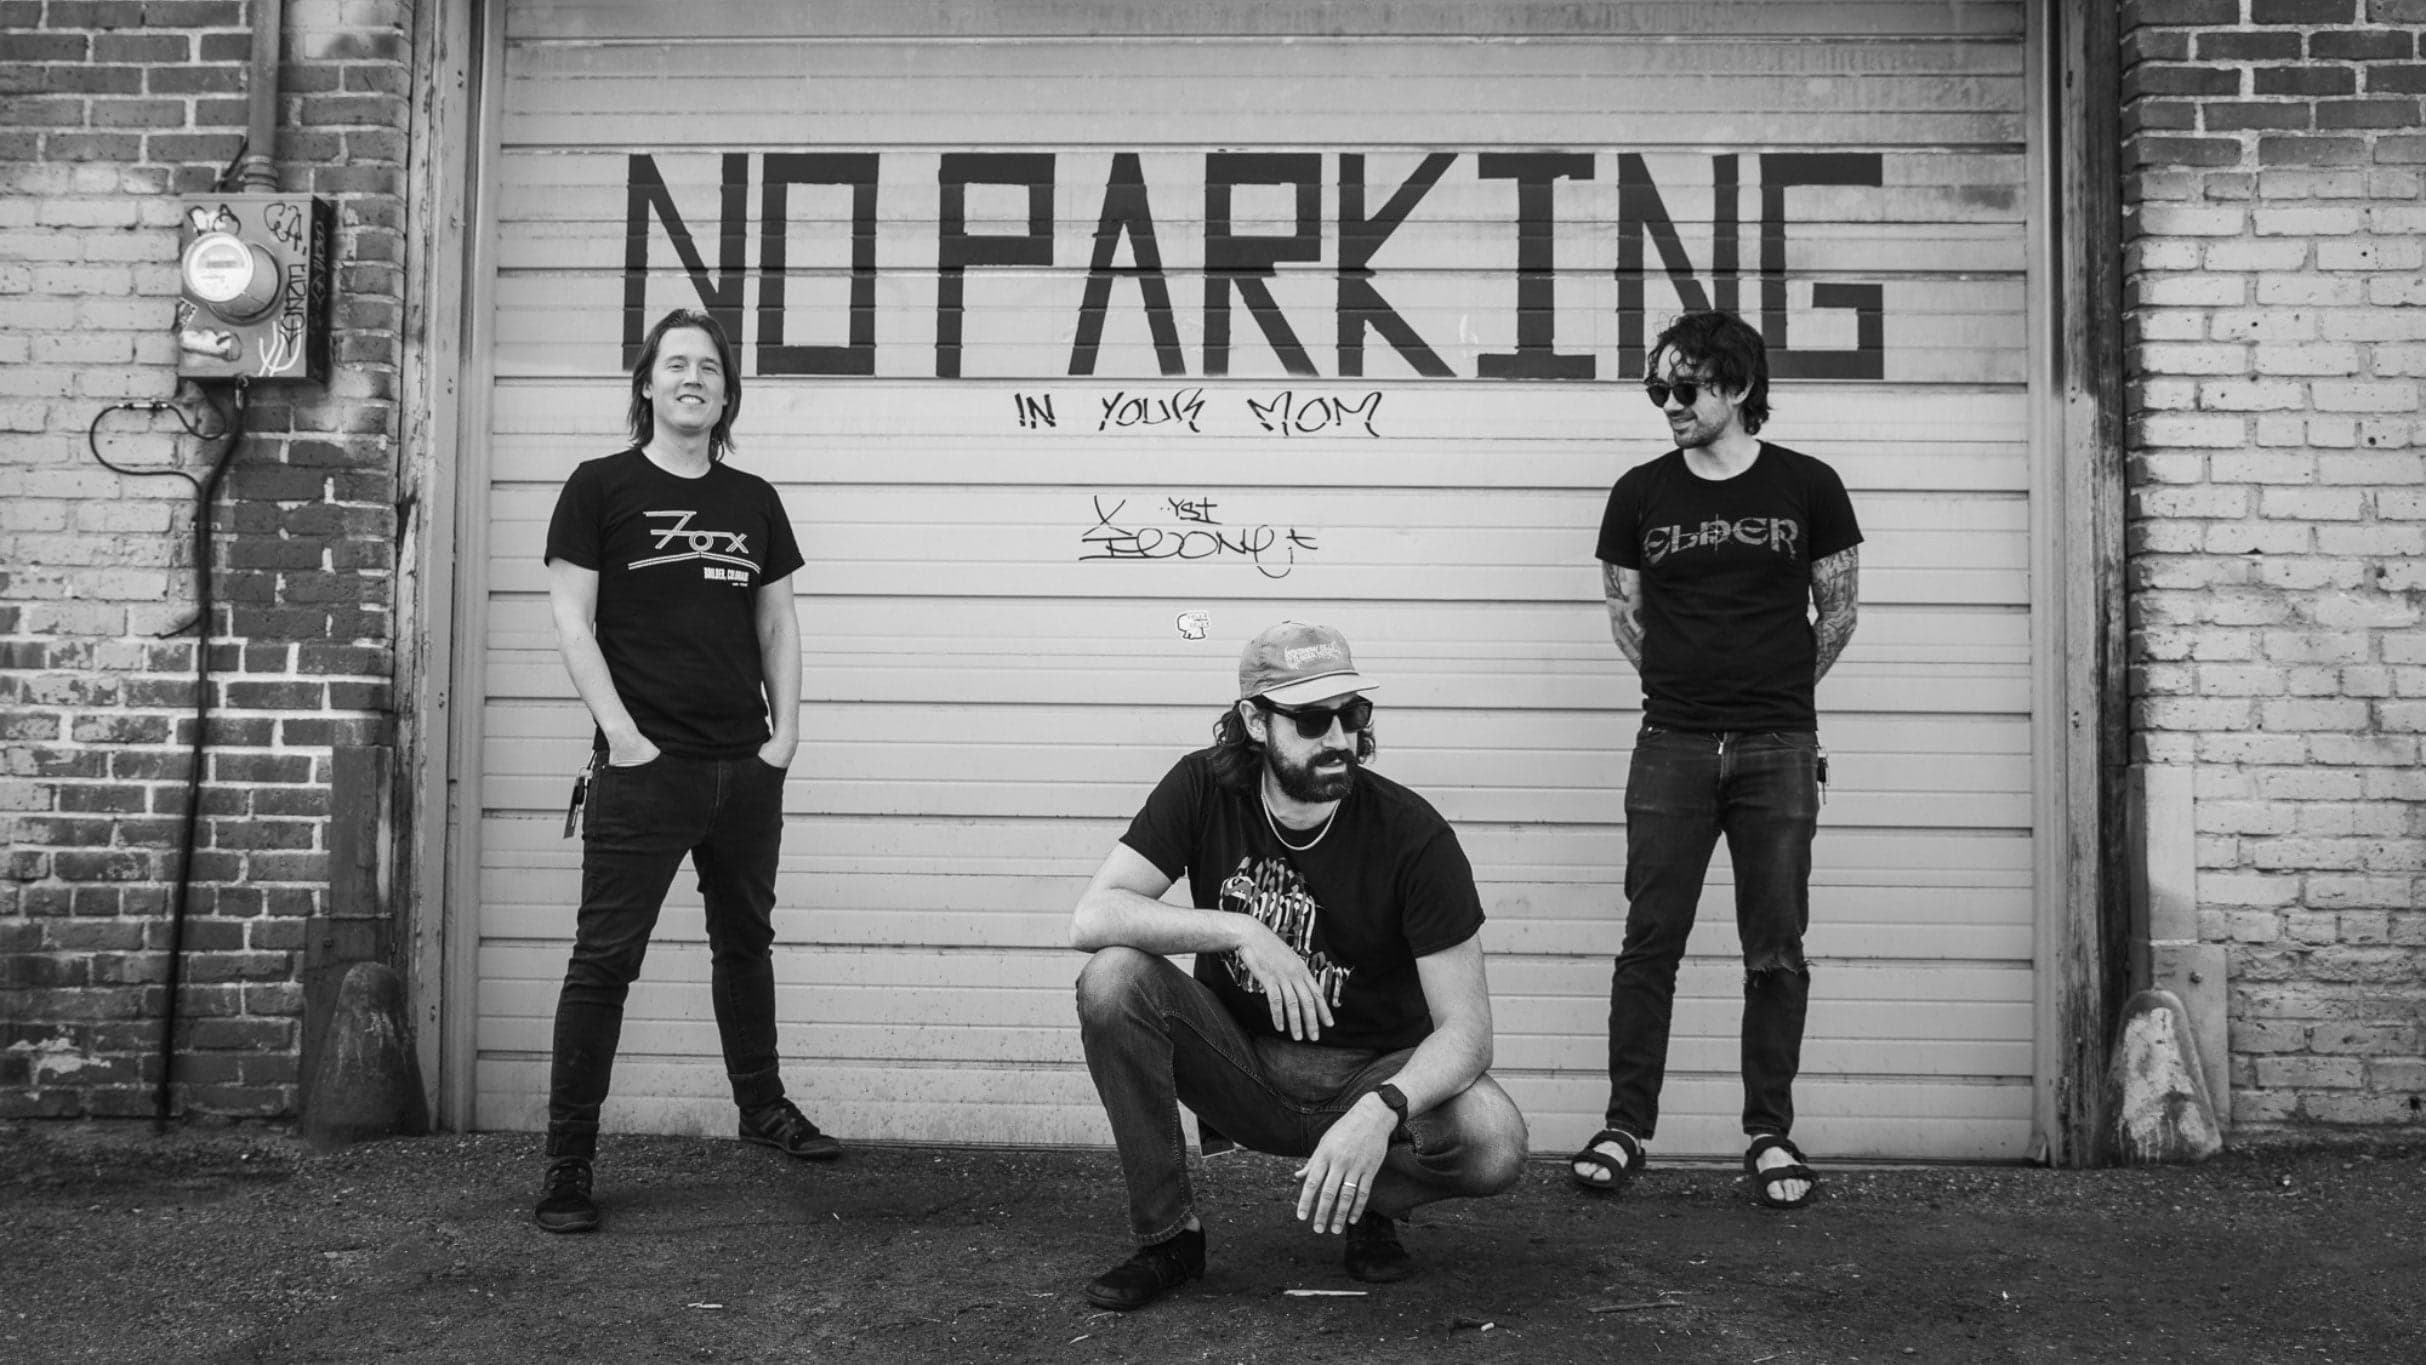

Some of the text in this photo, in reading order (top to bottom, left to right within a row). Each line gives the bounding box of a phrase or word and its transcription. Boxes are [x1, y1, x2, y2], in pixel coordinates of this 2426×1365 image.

[622, 153, 1884, 379] NO PARKING
[1014, 388, 1382, 437] IN YOUR MOM
